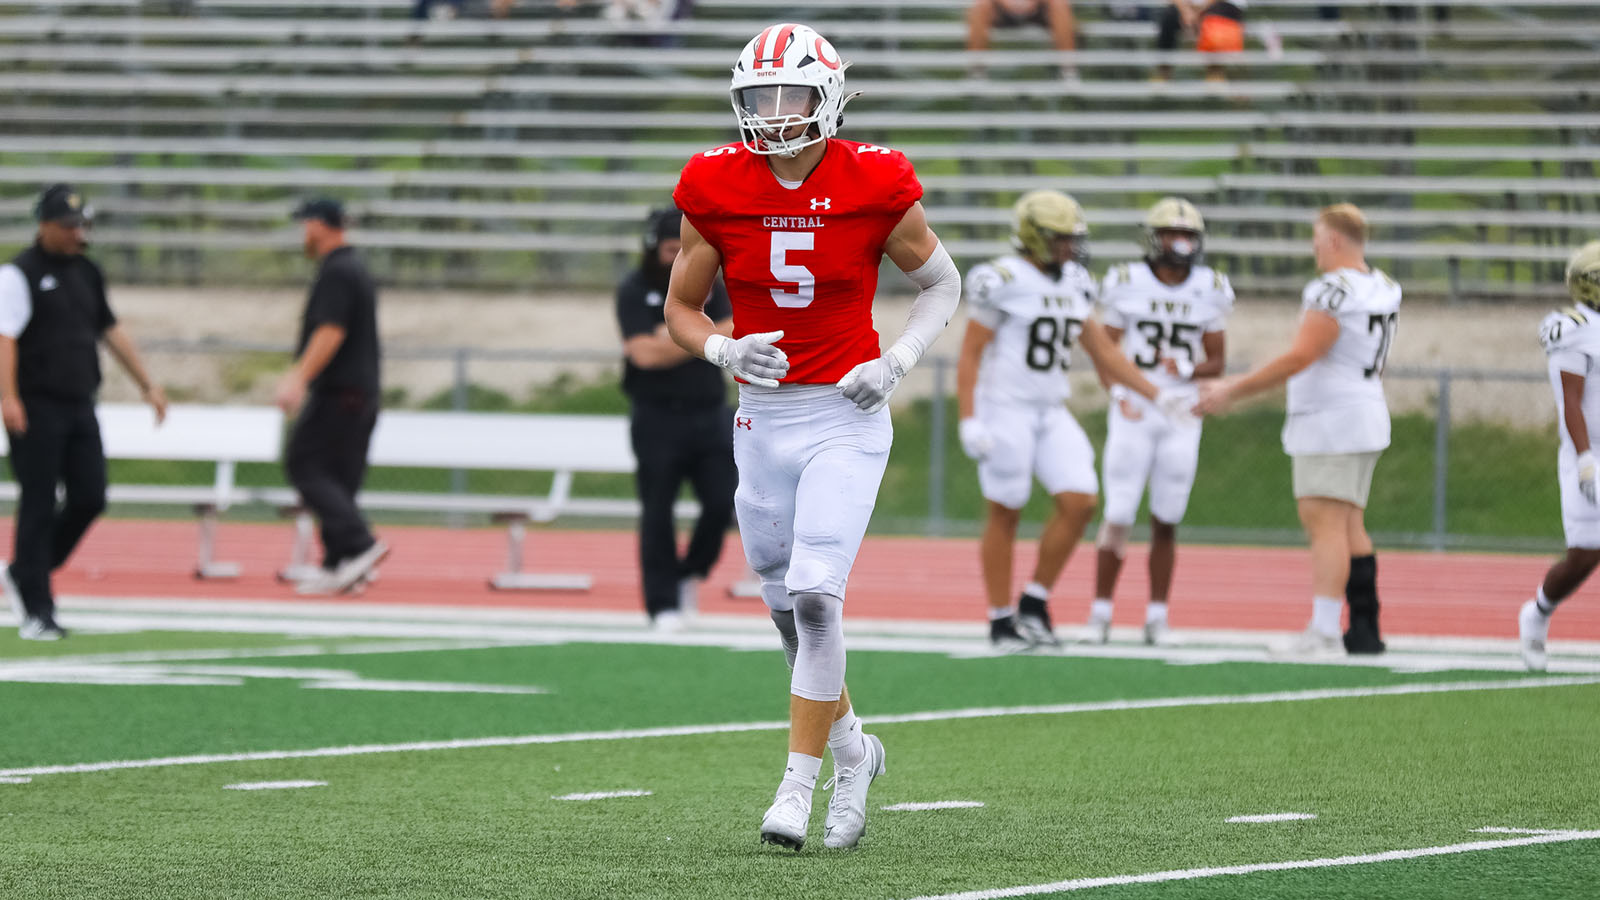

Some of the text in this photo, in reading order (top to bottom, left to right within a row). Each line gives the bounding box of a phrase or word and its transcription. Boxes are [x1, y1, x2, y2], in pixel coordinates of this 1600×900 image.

[763, 216, 824, 228] CENTRAL
[769, 231, 815, 308] 5
[1026, 317, 1083, 371] 85
[1135, 321, 1199, 368] 35
